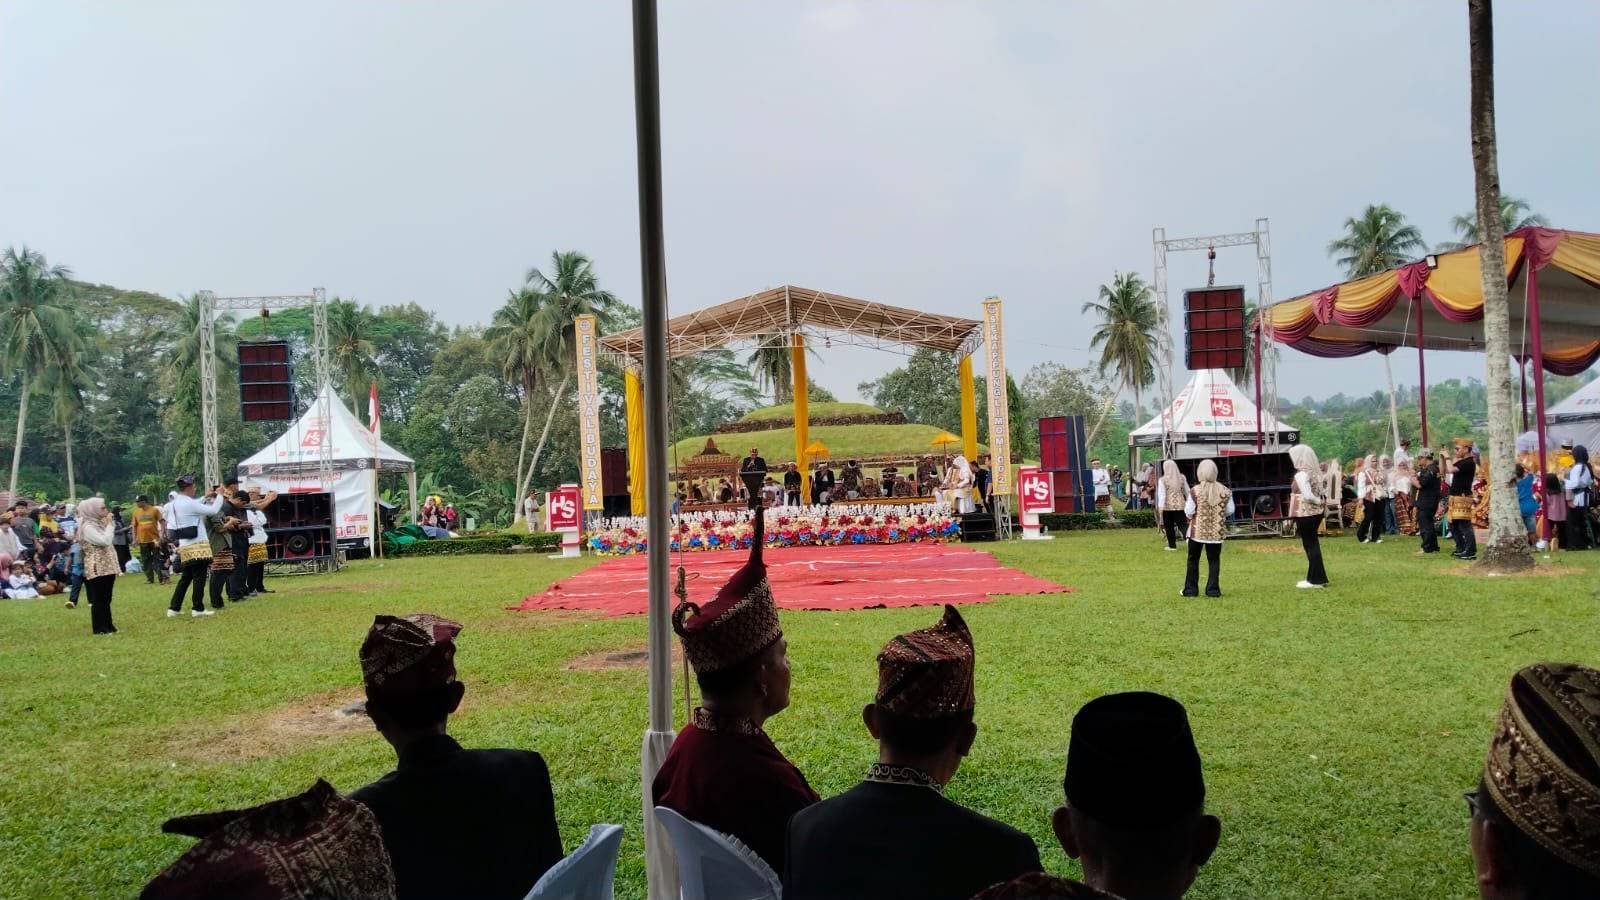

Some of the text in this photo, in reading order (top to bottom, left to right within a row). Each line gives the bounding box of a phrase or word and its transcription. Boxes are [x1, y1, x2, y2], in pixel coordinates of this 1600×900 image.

[582, 334, 598, 505] FESTIVAL BUDAYA
[1024, 477, 1049, 501] HS
[551, 495, 576, 519] HS
